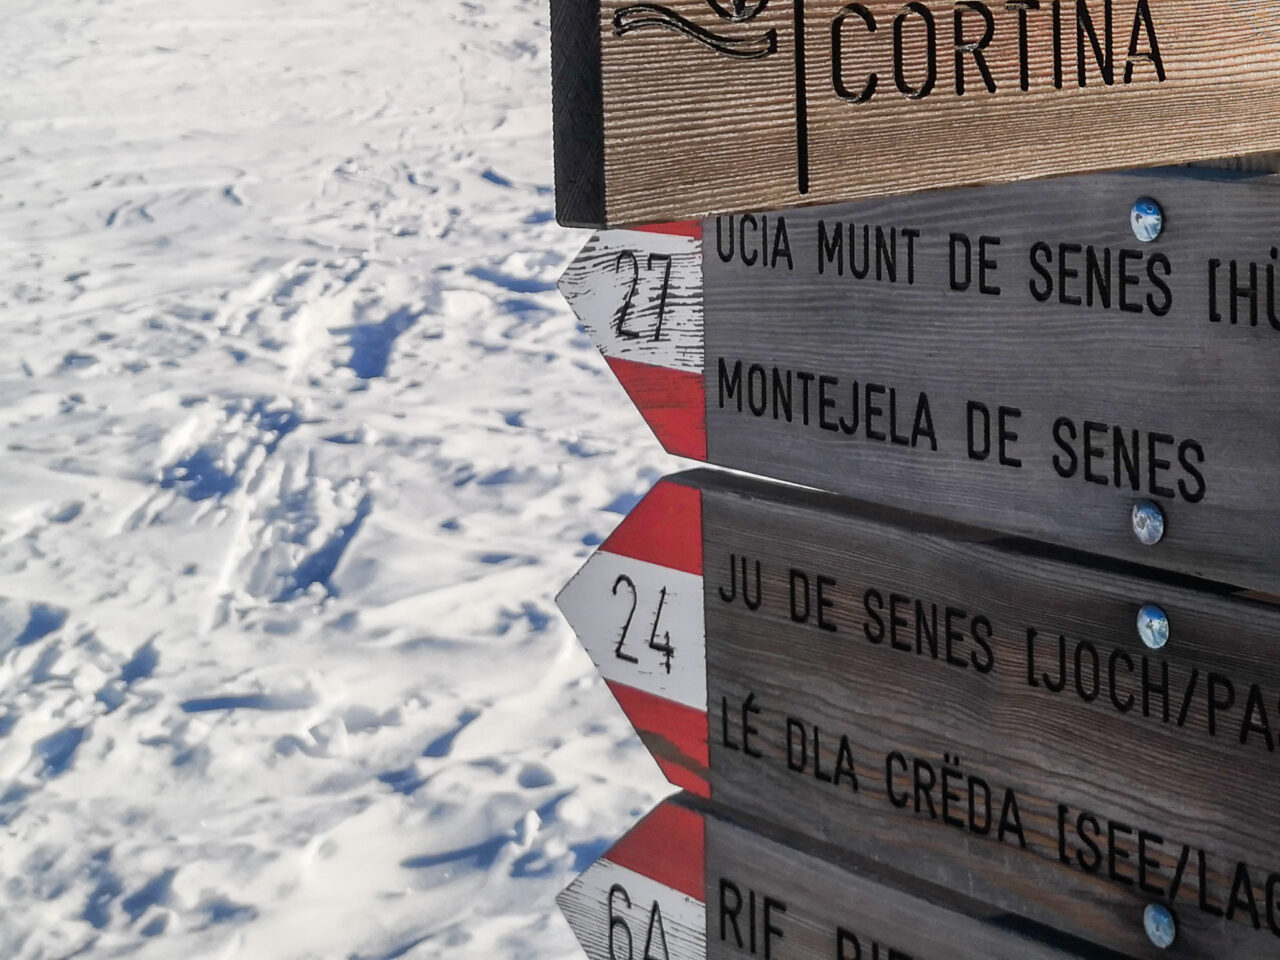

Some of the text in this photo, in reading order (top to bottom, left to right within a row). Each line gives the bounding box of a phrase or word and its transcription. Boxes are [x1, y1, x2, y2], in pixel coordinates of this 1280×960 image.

[615, 249, 671, 340] 27
[818, 219, 920, 285] MUNT
[949, 234, 1002, 296] DE
[1028, 240, 1172, 317] SENES
[717, 356, 1207, 504] MONTEJELA DE SENES
[612, 573, 674, 674] 24
[719, 553, 763, 611] JU
[788, 567, 837, 633] DE
[862, 588, 996, 674] SENES
[721, 693, 763, 758] LÉ
[785, 716, 860, 792] DLA
[885, 752, 1028, 849] CRËDA
[608, 883, 671, 960] 6A
